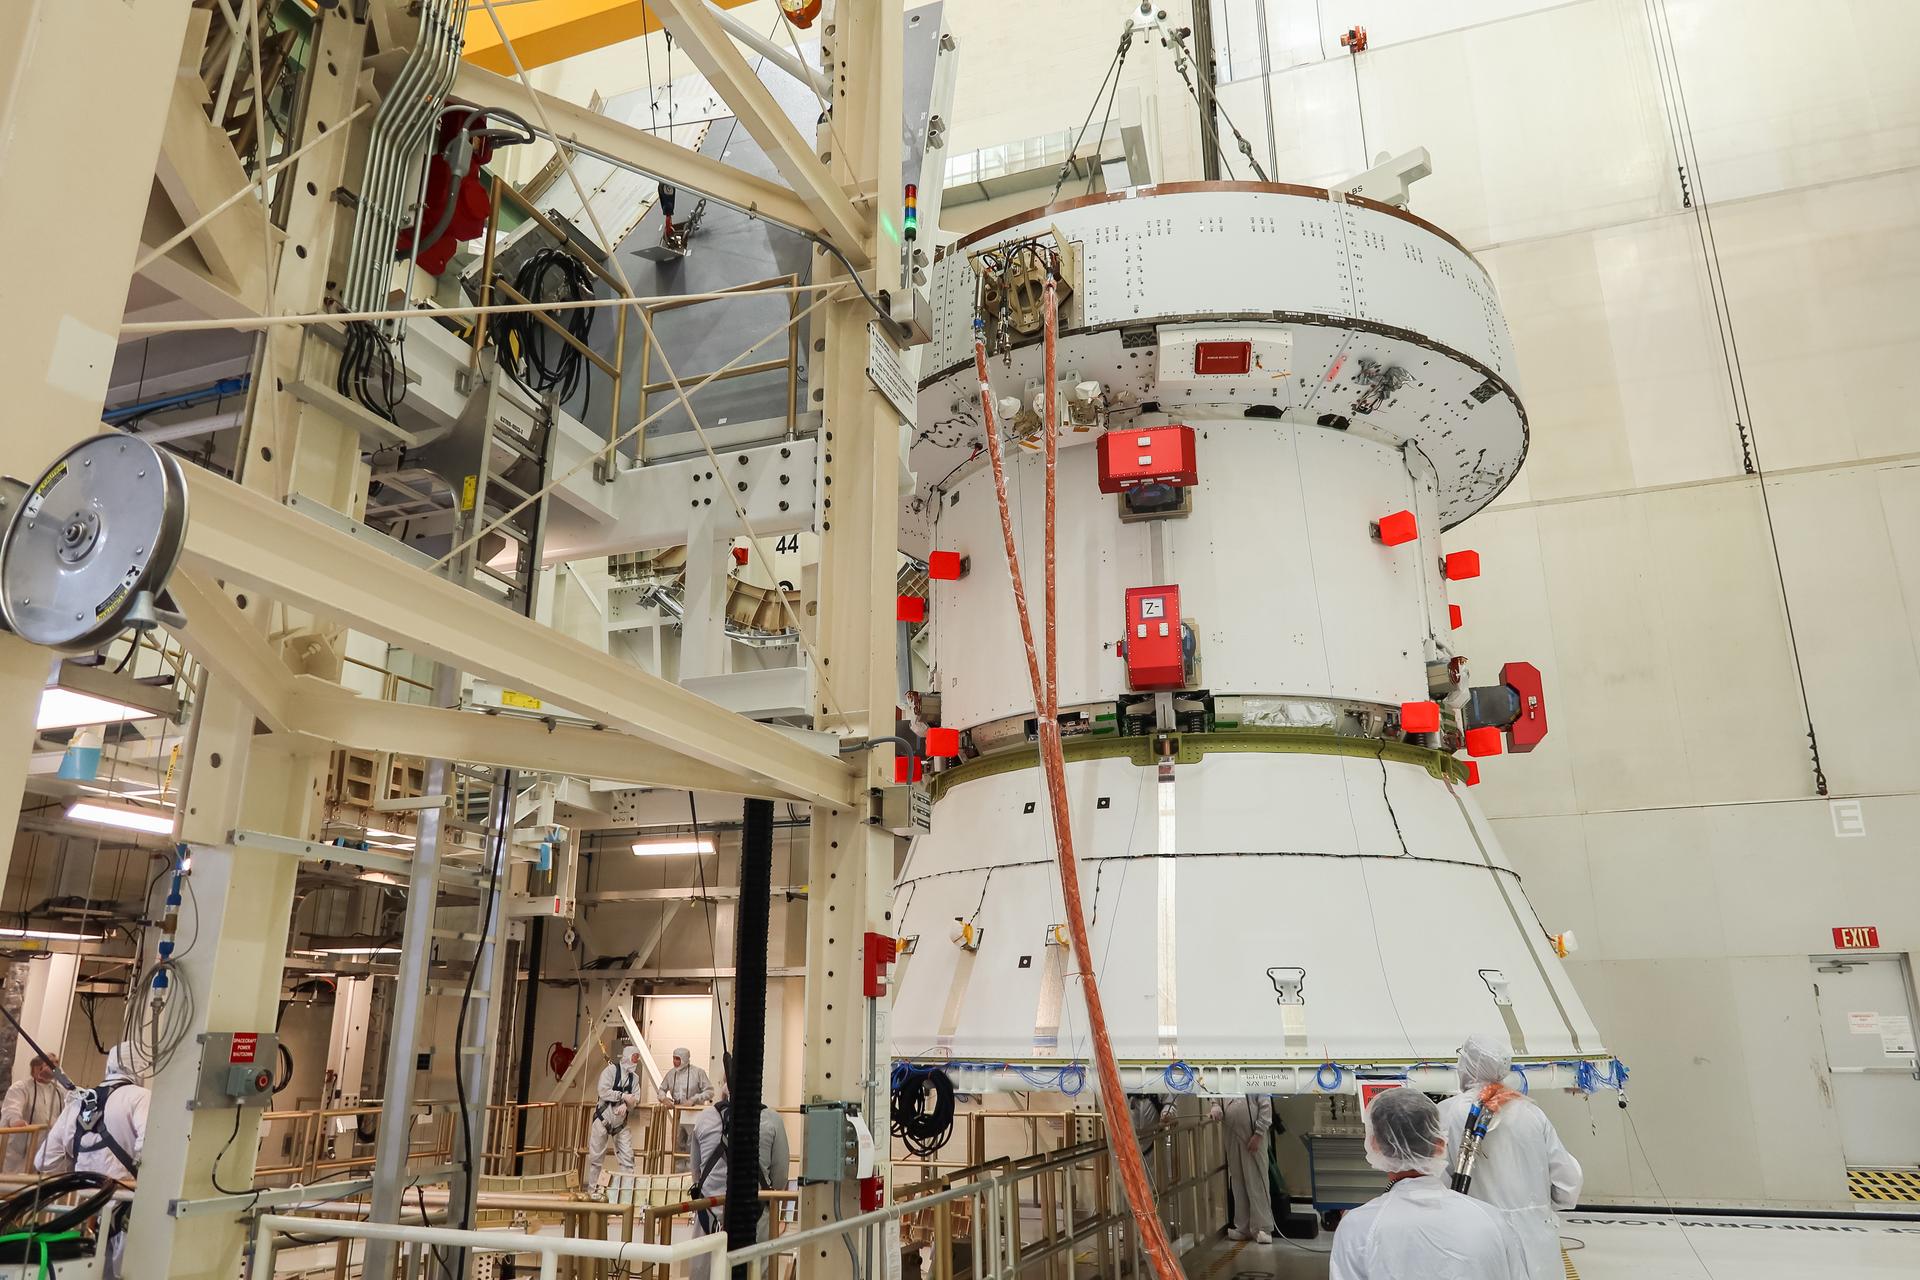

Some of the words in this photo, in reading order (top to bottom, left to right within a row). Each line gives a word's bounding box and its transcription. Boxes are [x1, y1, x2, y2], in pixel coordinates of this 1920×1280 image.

[775, 533, 799, 554] 44
[1145, 602, 1160, 614] Z-
[1841, 928, 1870, 947] EXIT
[1680, 1222, 1868, 1232] UNIFORM
